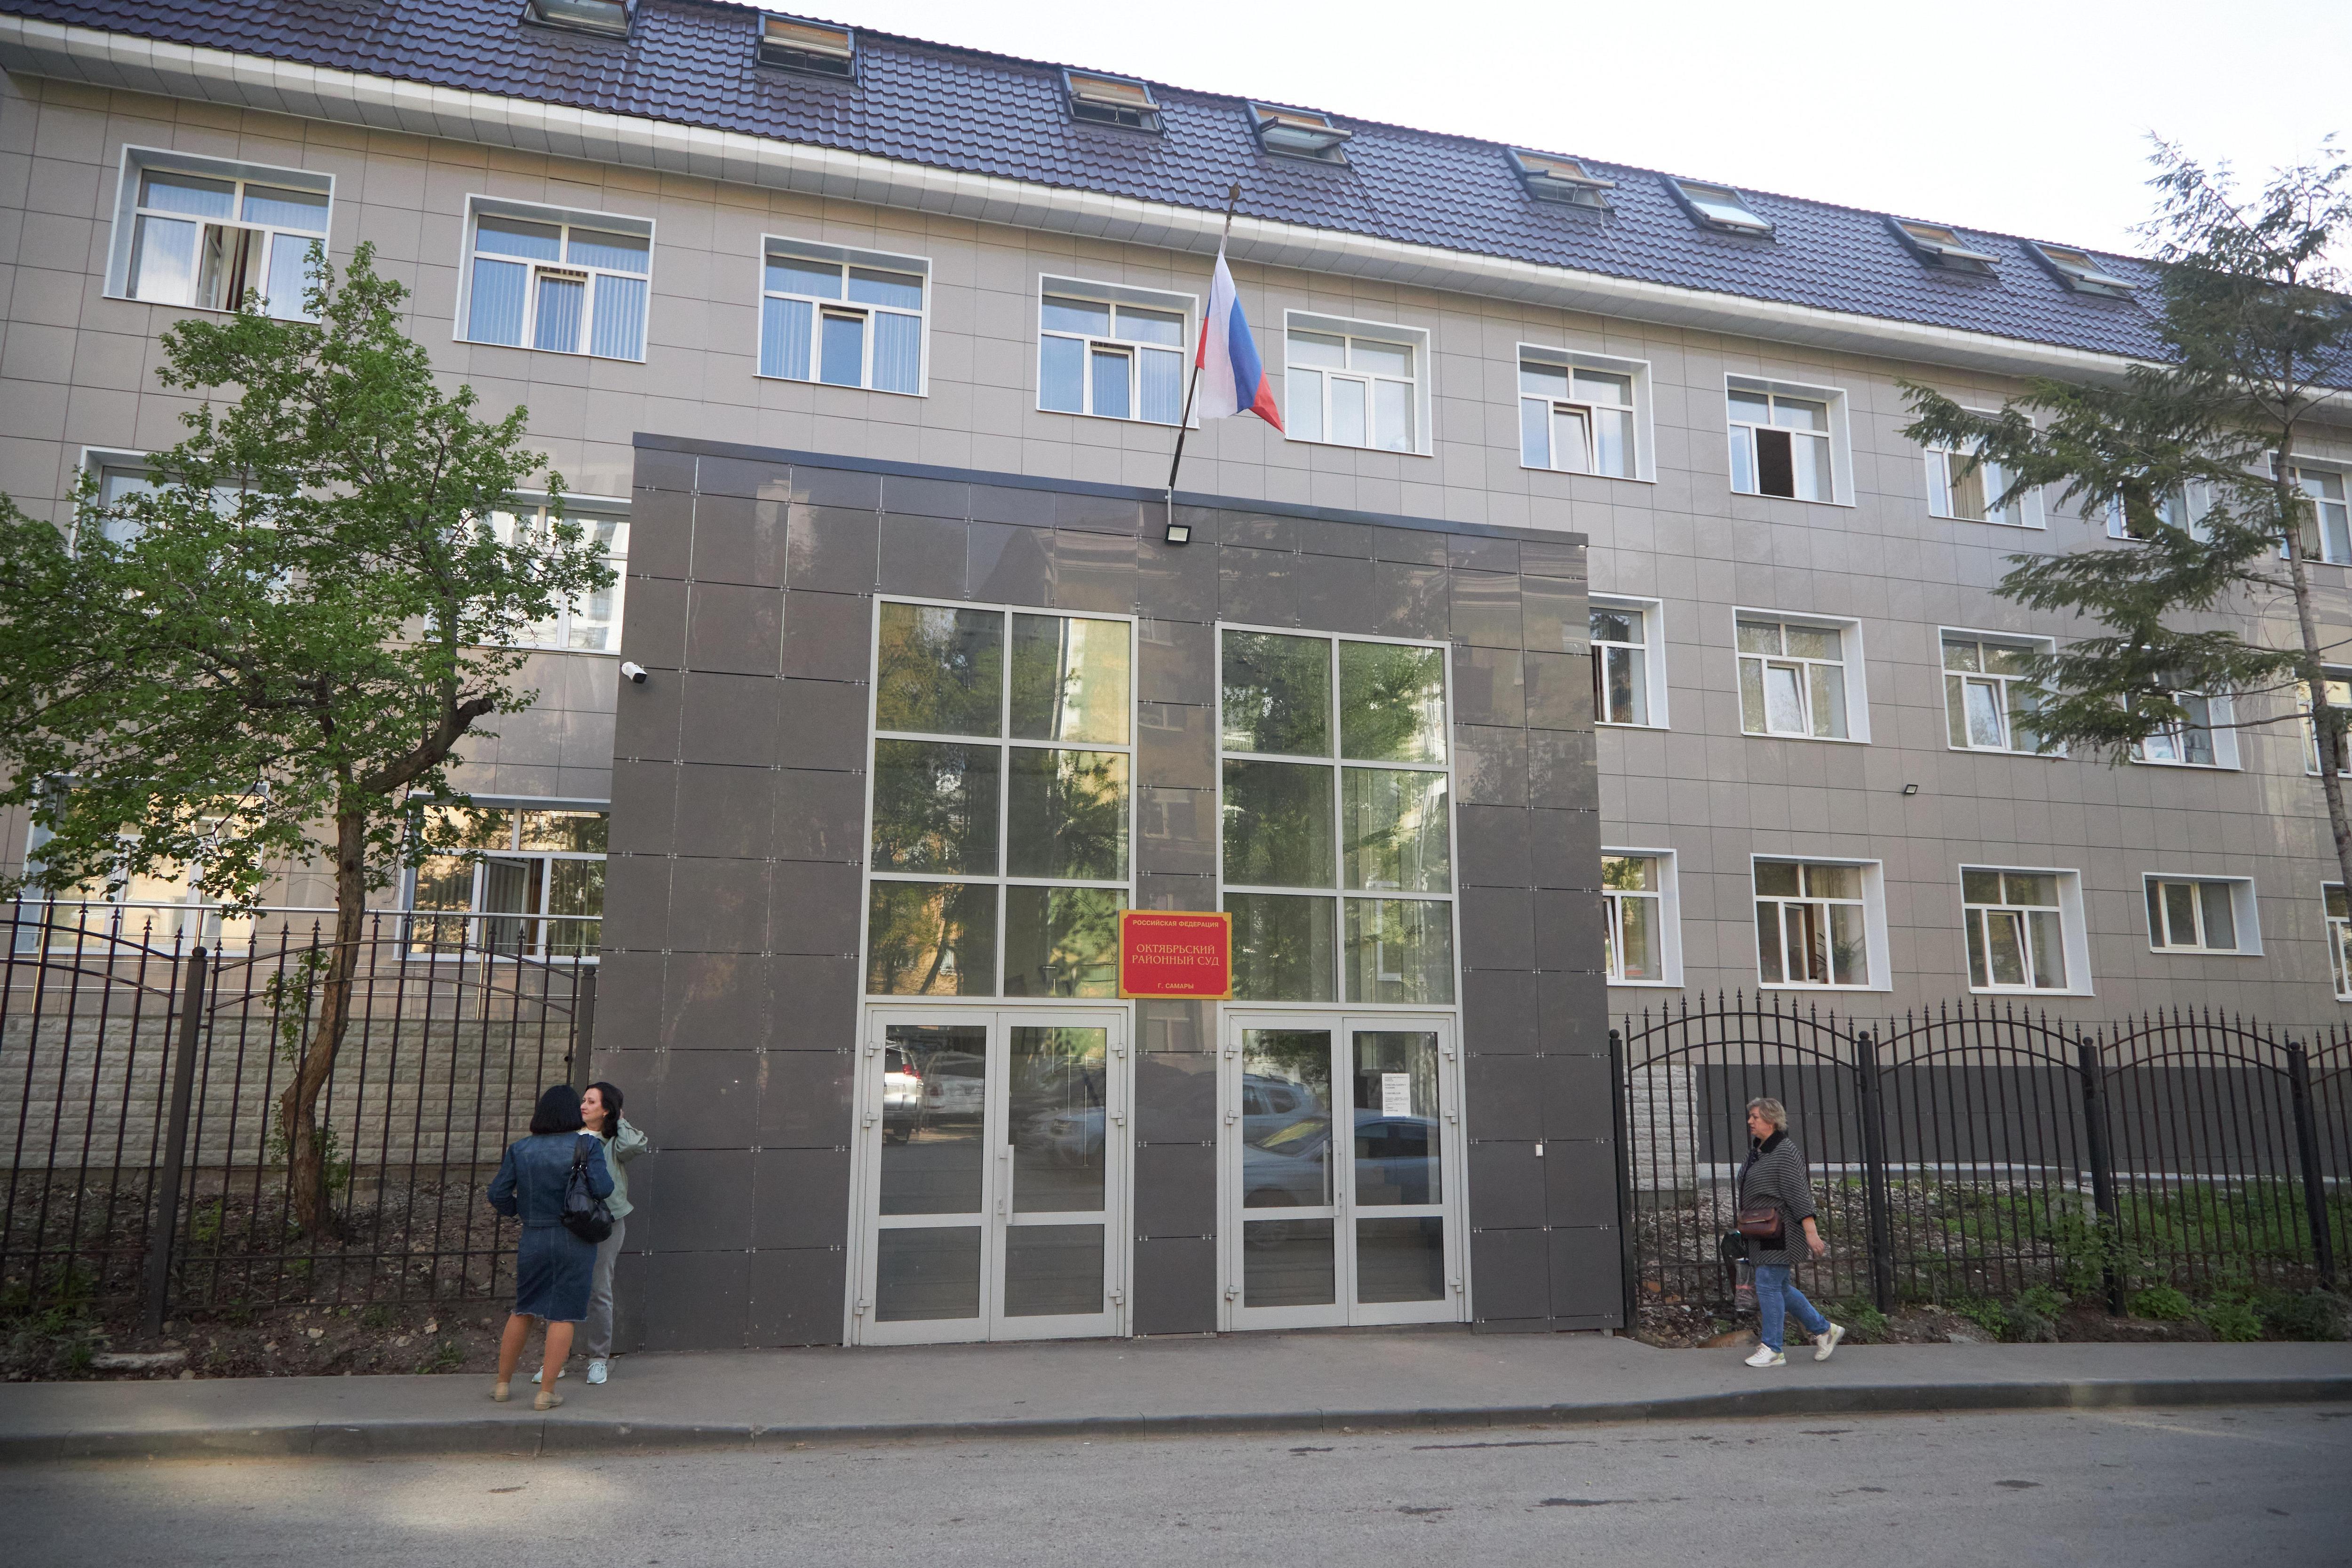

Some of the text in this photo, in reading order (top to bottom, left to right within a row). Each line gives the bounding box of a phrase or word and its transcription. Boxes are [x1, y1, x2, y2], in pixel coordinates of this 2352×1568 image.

[1136, 944, 1215, 954] ОКТЯБРЬСКИЙ
[1132, 954, 1219, 966] РАЙОННЫЙ СУД
